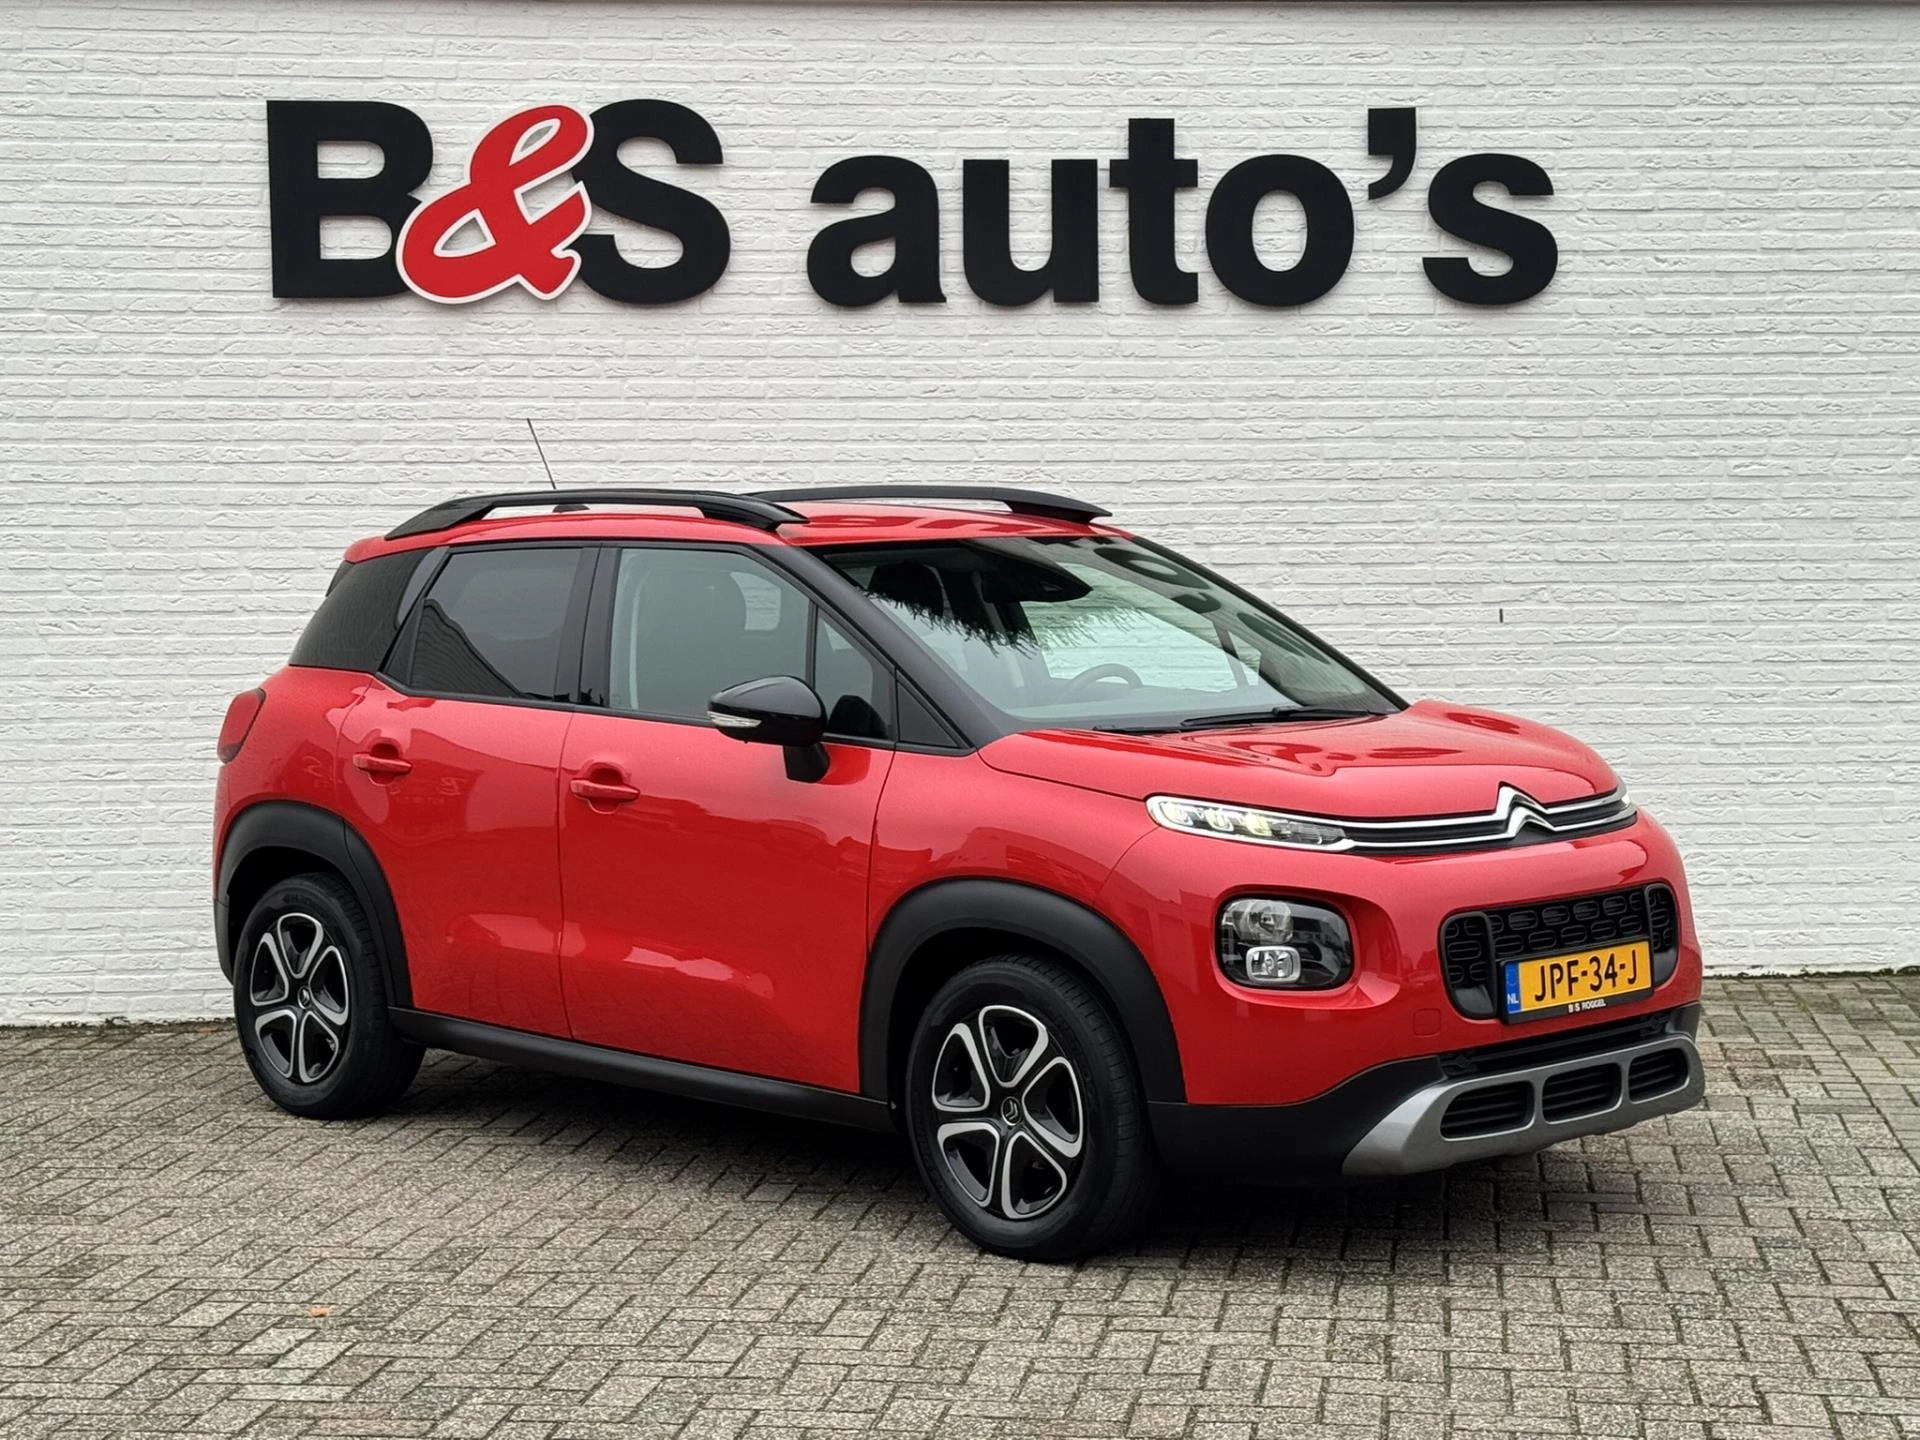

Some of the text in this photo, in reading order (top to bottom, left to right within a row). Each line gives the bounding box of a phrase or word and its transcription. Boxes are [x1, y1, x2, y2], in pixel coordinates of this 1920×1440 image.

[266, 98, 1559, 308] B&S auto's
[1507, 993, 1519, 1005] NL
[1534, 949, 1637, 1002] JPF-34-J
